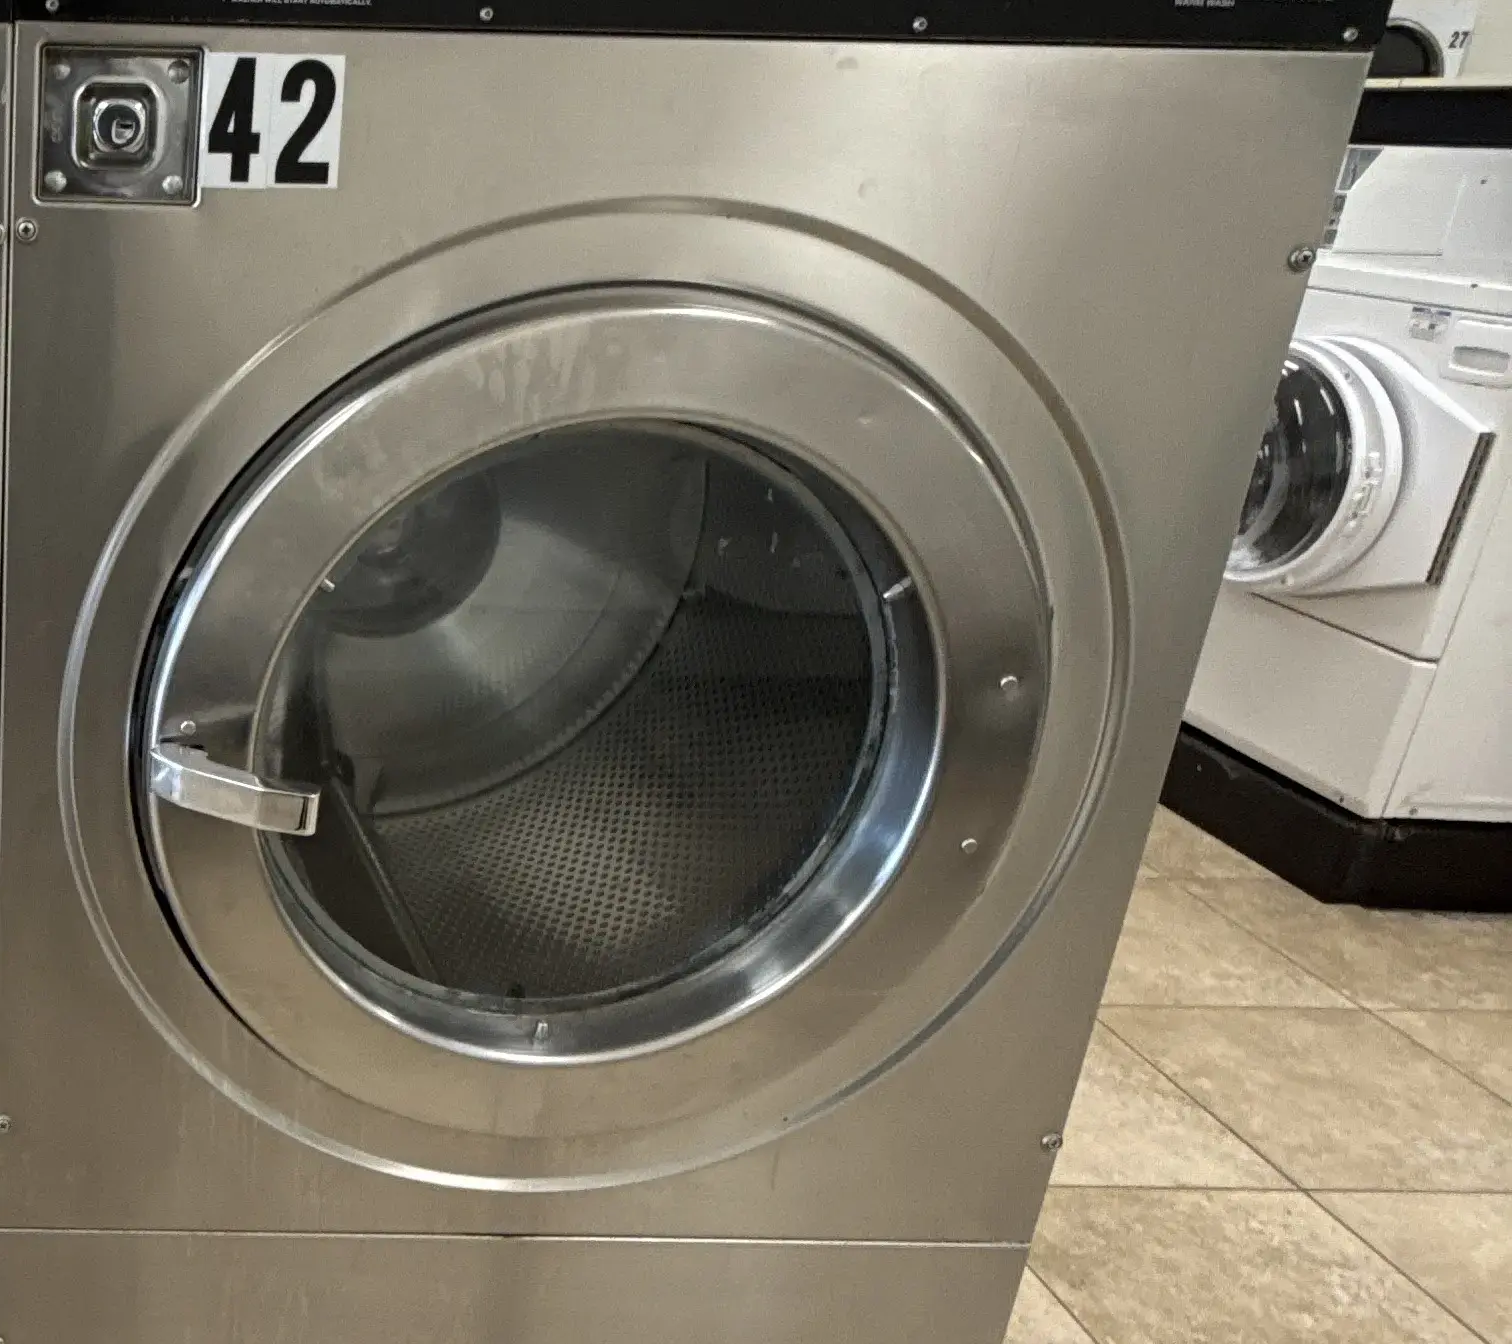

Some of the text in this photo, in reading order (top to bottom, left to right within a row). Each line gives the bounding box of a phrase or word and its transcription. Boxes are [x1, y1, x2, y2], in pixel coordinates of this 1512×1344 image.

[1206, 0, 1236, 7] WASH
[1448, 31, 1470, 48] 27
[208, 57, 336, 184] 42
